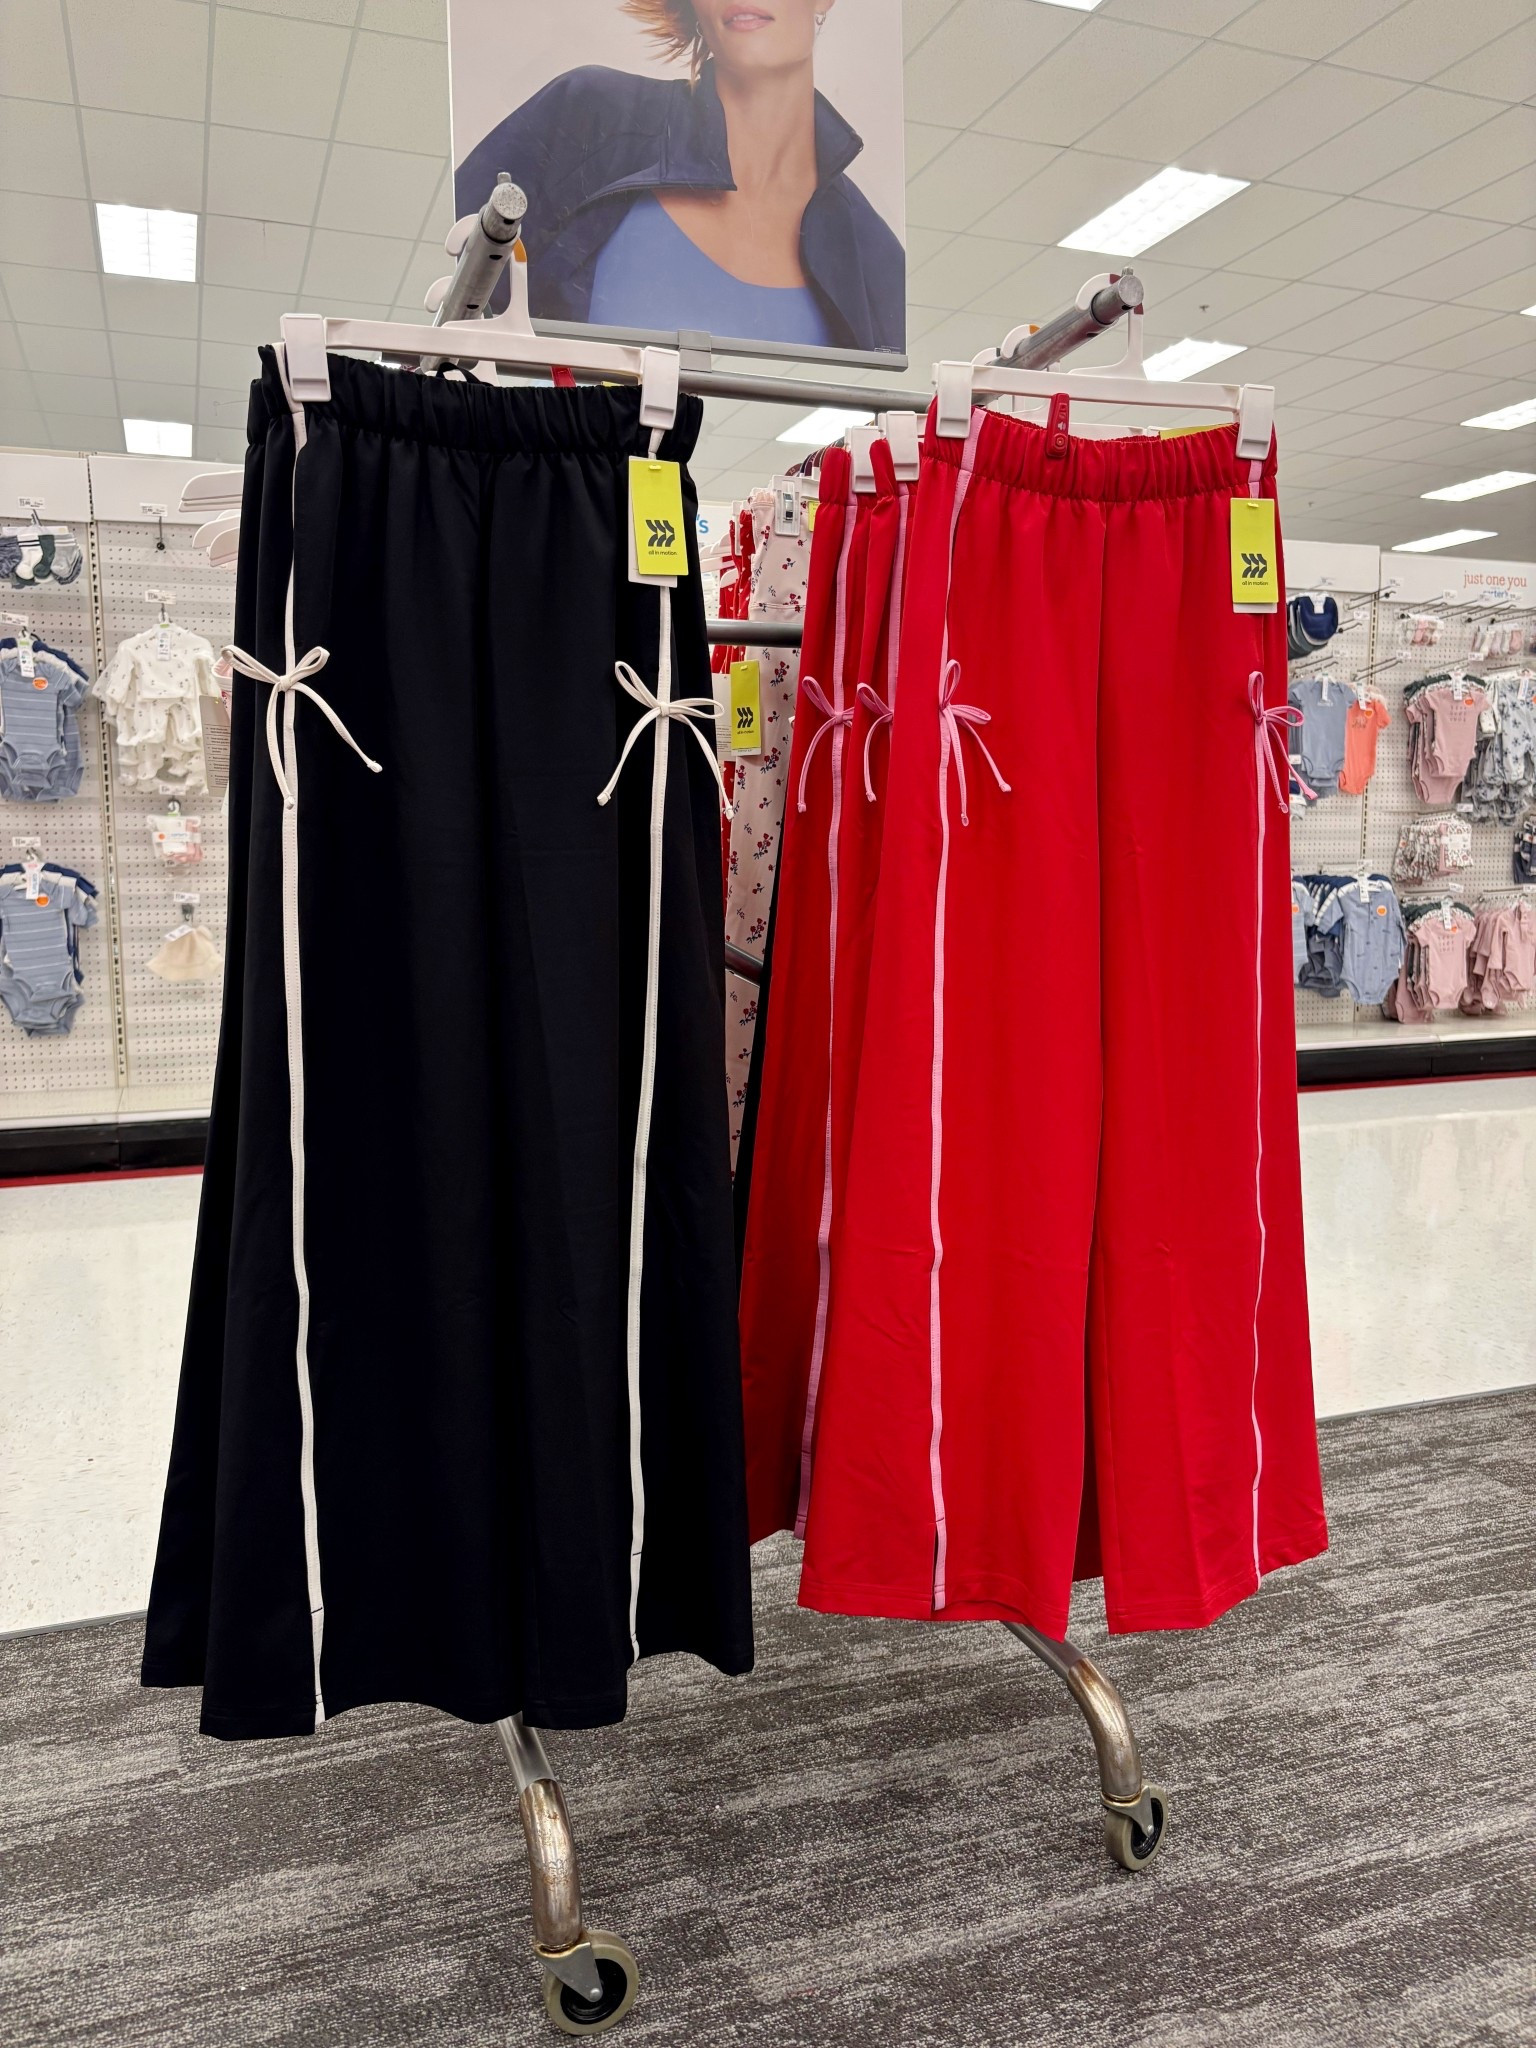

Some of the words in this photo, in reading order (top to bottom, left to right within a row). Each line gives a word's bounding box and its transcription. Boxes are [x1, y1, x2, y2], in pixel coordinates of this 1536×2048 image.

[1463, 569, 1484, 589] just
[1485, 575, 1506, 587] one
[1507, 576, 1527, 591] you
